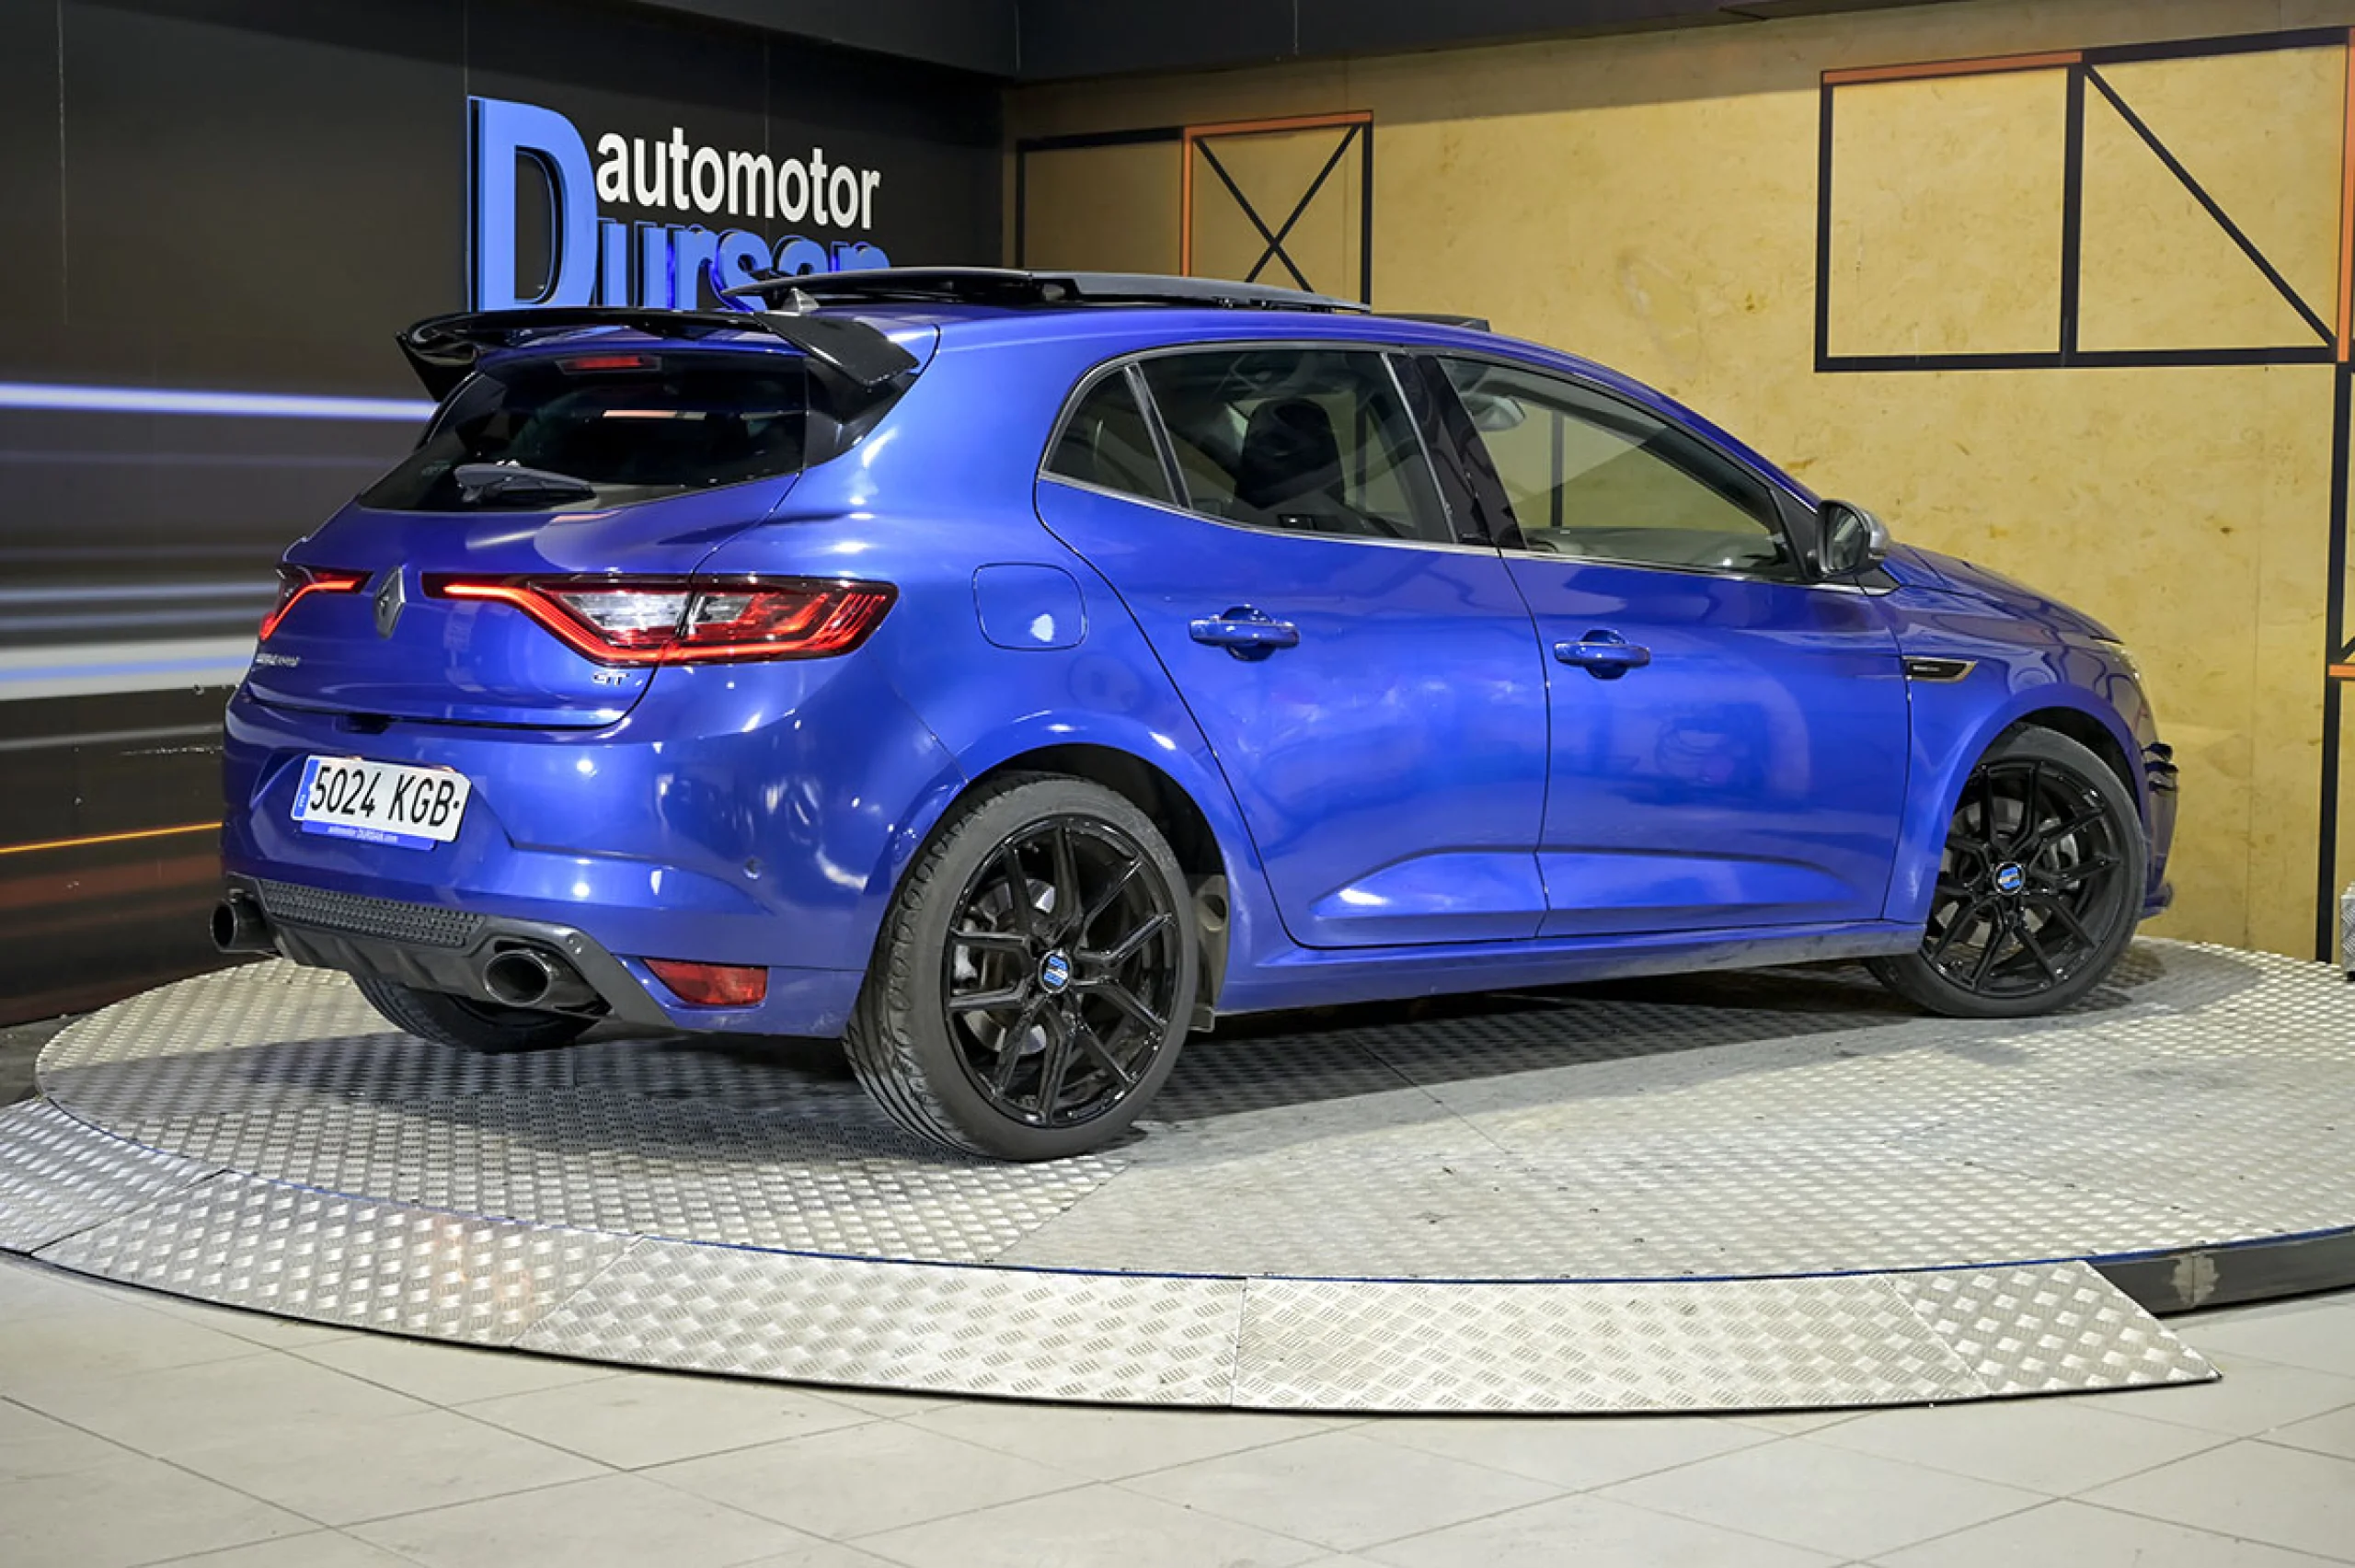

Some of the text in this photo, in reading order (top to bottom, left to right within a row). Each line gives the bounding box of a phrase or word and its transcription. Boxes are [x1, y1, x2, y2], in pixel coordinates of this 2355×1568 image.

[467, 96, 890, 311] Durs
[595, 127, 880, 229] automotor
[592, 671, 630, 686] GT
[310, 766, 454, 827] 5024 KGB
